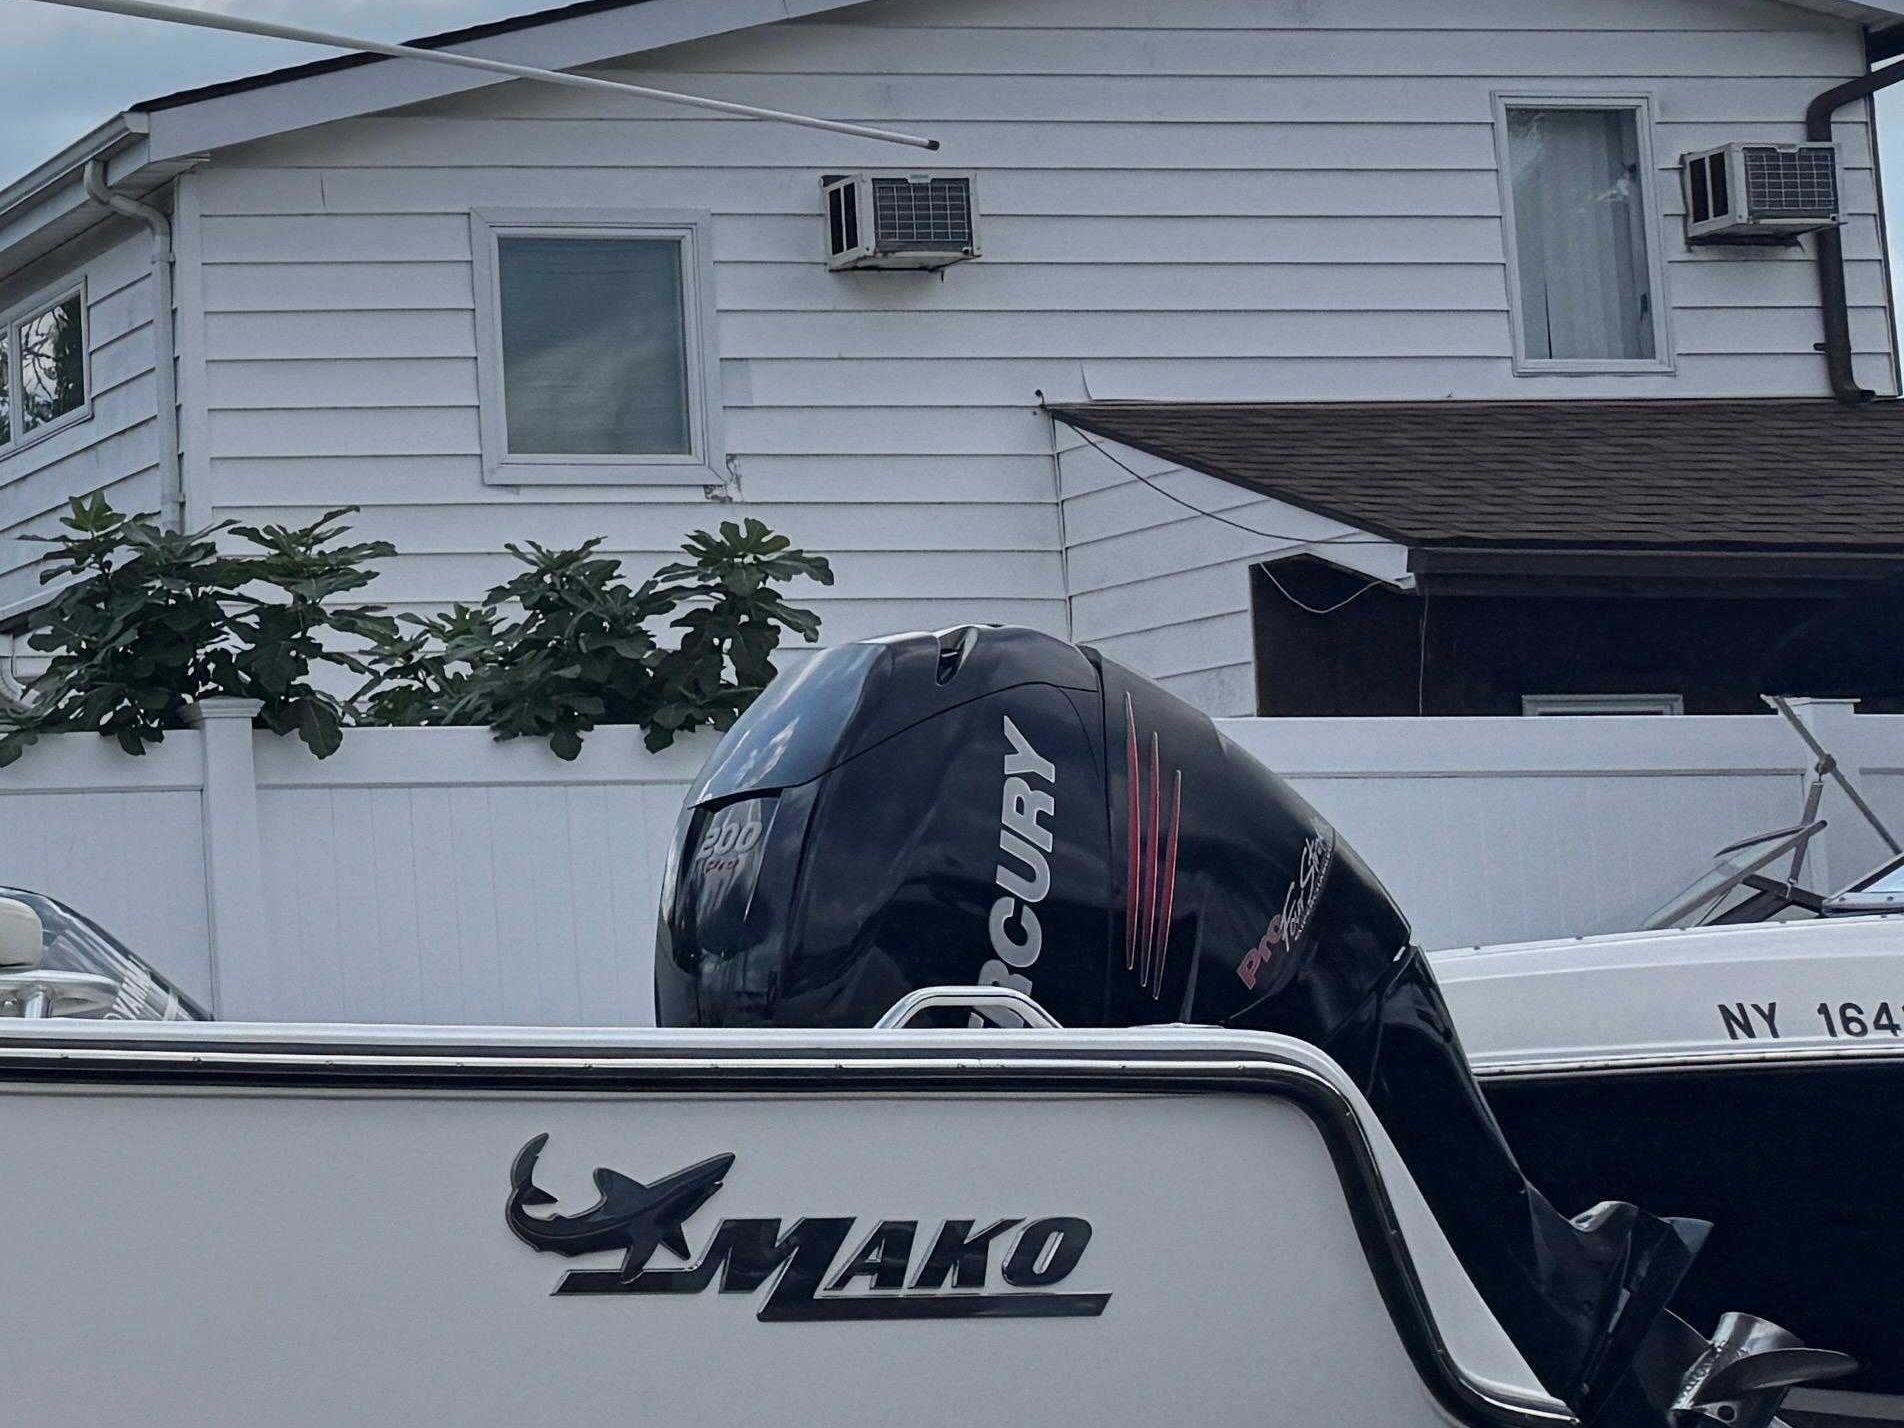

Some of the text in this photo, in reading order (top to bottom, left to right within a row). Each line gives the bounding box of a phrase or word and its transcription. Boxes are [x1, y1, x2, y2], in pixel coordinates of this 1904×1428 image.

[695, 821, 763, 861] 200
[968, 715, 1055, 1028] RCURY
[1236, 913, 1282, 990] Pro
[1717, 1002, 1904, 1040] NY 164
[692, 1216, 1112, 1322] MAKO
